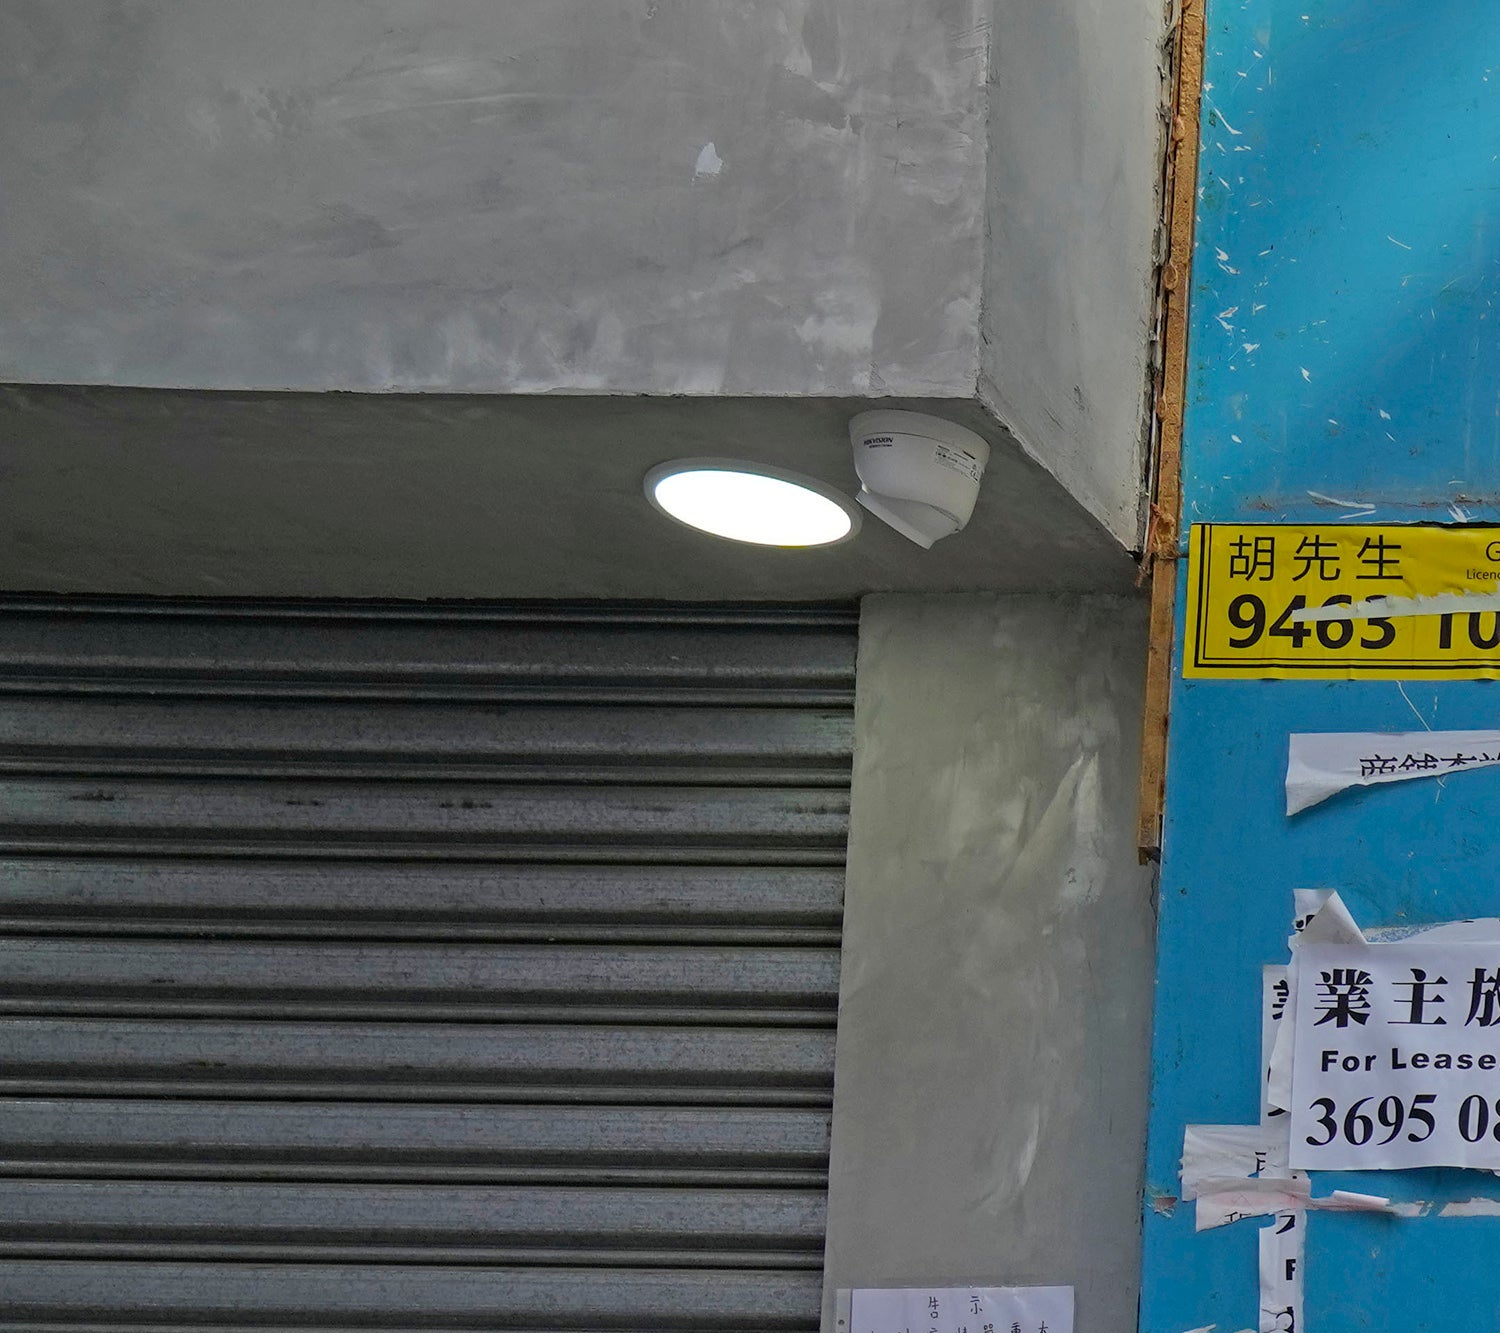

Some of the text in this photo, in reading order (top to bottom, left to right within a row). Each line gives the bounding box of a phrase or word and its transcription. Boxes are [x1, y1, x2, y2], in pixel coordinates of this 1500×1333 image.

[1228, 534, 1404, 584] 胡先生
[1227, 594, 1397, 650] 9463
[1321, 1049, 1377, 1073] For
[1305, 1094, 1439, 1147] 3695
